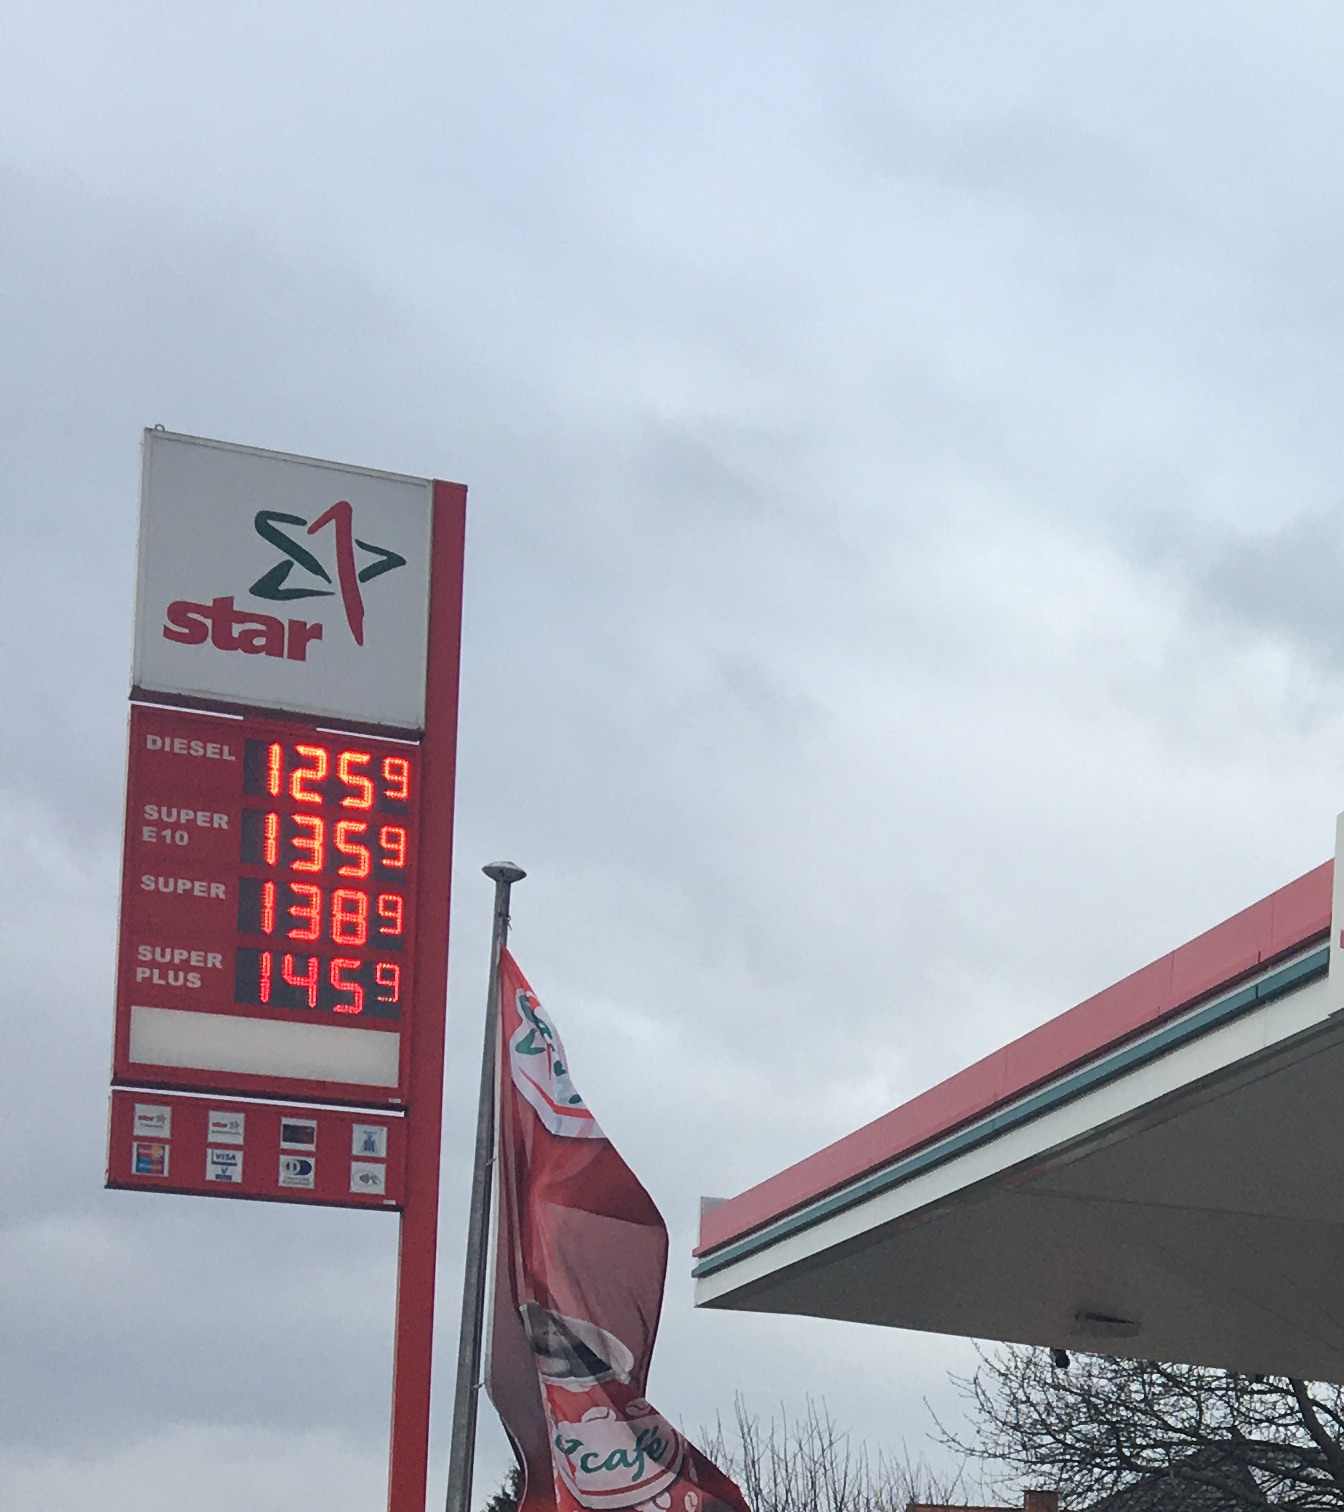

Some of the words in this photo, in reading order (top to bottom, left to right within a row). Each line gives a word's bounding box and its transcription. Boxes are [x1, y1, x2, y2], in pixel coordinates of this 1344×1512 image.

[162, 595, 323, 662] star
[146, 734, 236, 762] DIESEL
[143, 804, 230, 830] SUPER
[140, 875, 226, 900] SUPER
[136, 945, 224, 969] SUPER
[135, 967, 202, 988] PLUS
[579, 1425, 669, 1482] café
